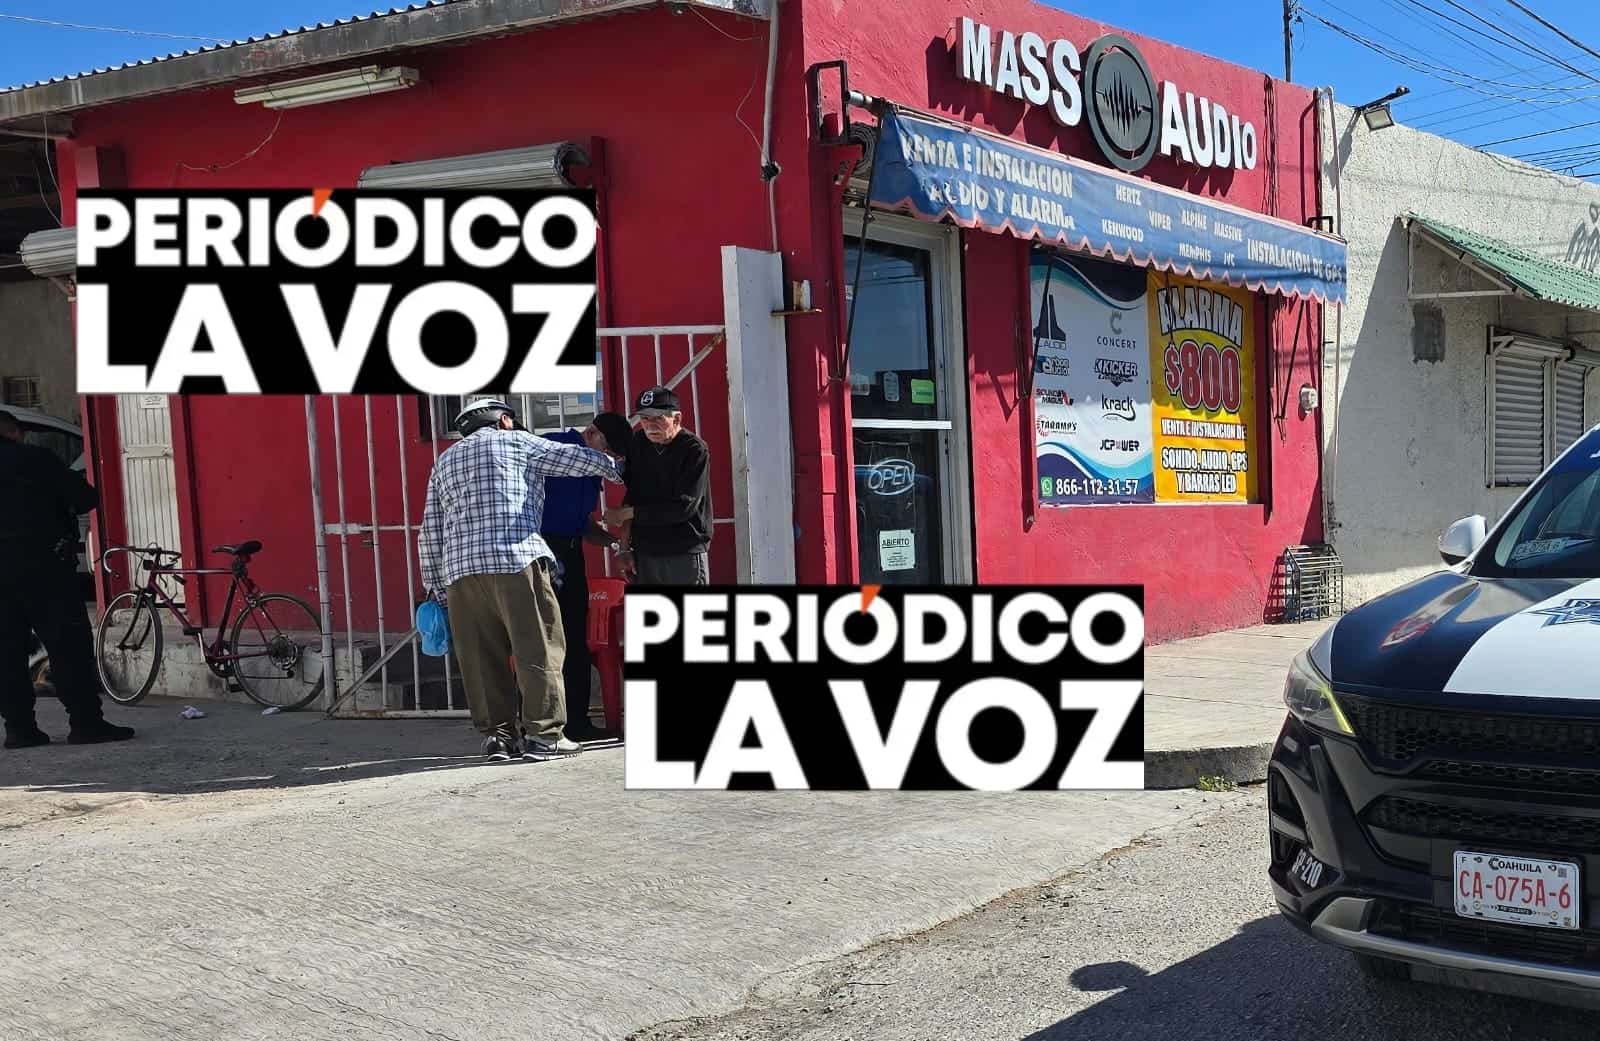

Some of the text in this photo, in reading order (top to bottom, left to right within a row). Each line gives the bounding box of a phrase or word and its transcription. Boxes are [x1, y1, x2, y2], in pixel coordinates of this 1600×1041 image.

[958, 16, 1257, 170] MASS AUDIO
[963, 142, 973, 173] E
[975, 146, 1074, 198] INSTALACION
[994, 187, 1005, 214] Y
[1115, 183, 1142, 206] HERTZ
[1101, 218, 1144, 242] KENWOOD
[1148, 209, 1171, 231] VIPER
[1181, 209, 1207, 231] ALPINE
[1213, 221, 1243, 242] MASSIVE
[1178, 242, 1211, 264] MEMPHIS
[1247, 238, 1310, 273] INSTALACION
[1157, 285, 1243, 350] ALARMA
[1096, 335, 1137, 350] CONCERT
[1164, 339, 1241, 414] $800
[1161, 418, 1186, 436] VENTA
[1186, 420, 1192, 436] E
[1191, 420, 1235, 439] INSTALACION
[1231, 450, 1248, 472] GPS
[868, 466, 915, 489] OPEN
[1055, 478, 1139, 495] 866-112-31-57
[1176, 471, 1236, 494] Y BARRAS LED
[1459, 870, 1571, 909] CA-075A-6
